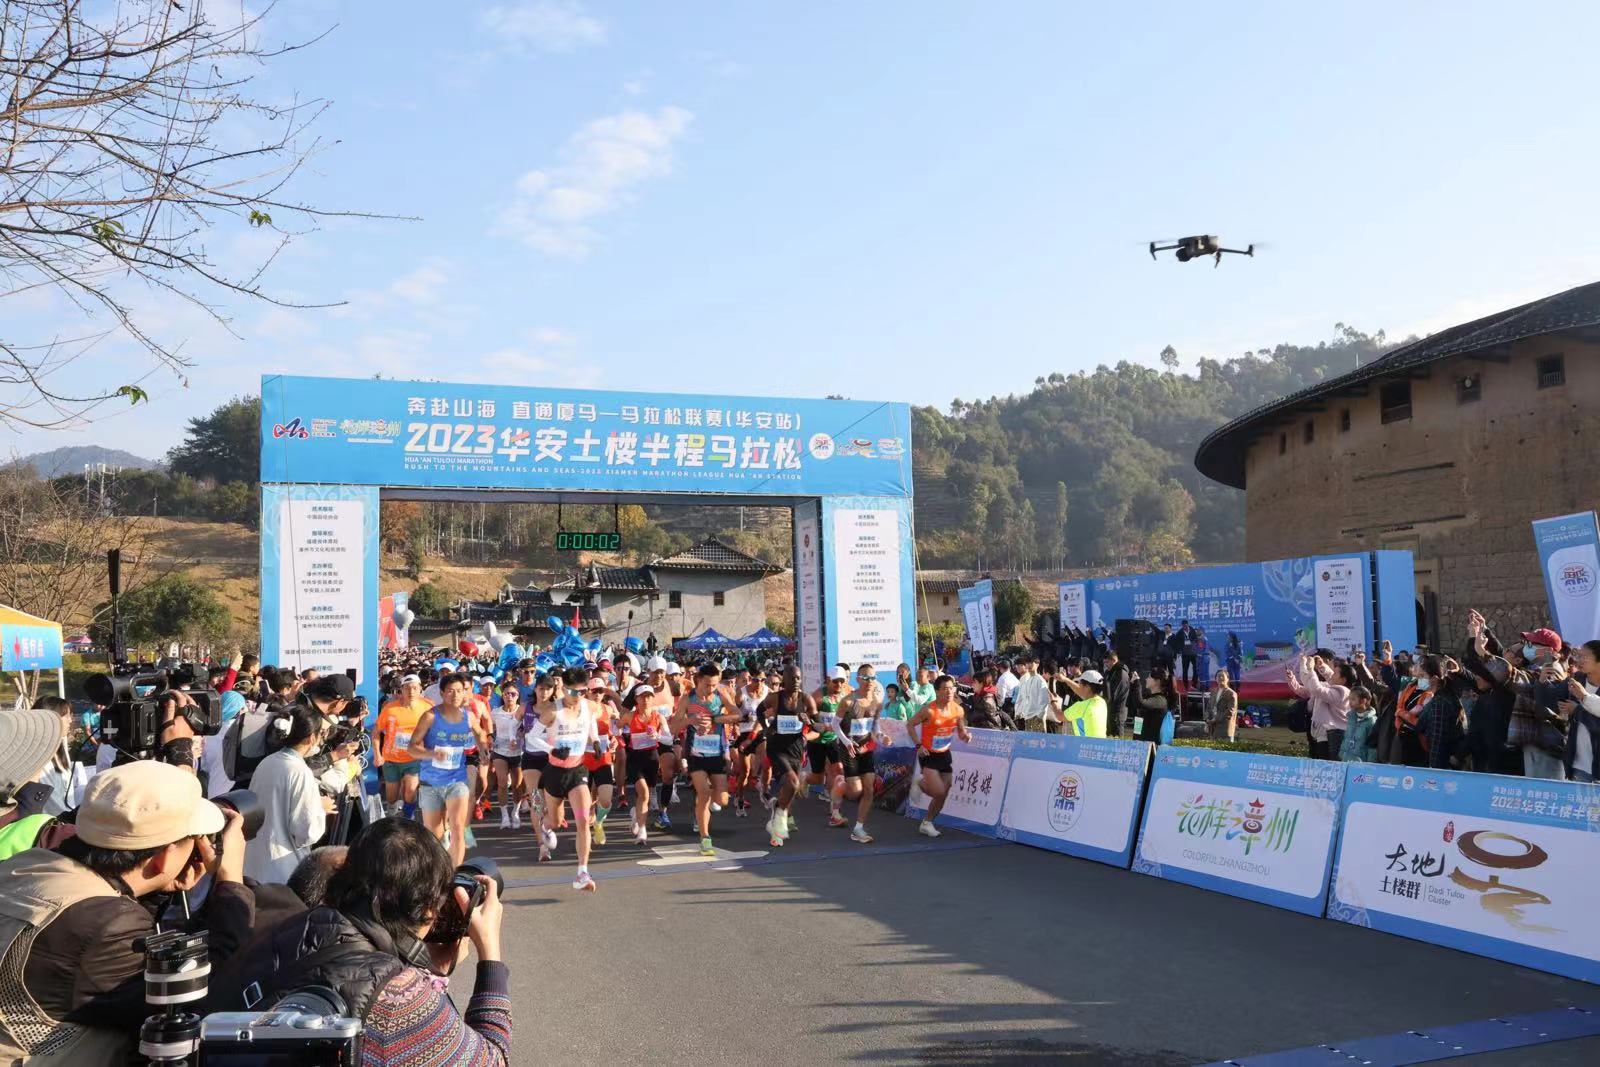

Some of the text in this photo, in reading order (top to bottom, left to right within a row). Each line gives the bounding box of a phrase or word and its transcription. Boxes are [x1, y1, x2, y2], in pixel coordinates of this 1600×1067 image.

[407, 397, 496, 418] 奔赴山海
[404, 422, 803, 471] 2023华安土楼半程马拉松
[473, 465, 528, 473] MOUNTAINS
[642, 469, 689, 477] MARATHON
[558, 534, 620, 548] 0:00:02
[1134, 598, 1256, 621] 2023华安土楼半程马拉松
[1182, 849, 1271, 876] COLORFUL ZHANGZHOU
[1385, 843, 1445, 877] 大地
[1378, 875, 1422, 900] 土楼群
[1428, 885, 1466, 899] Dadi Tulou
[1428, 894, 1452, 905] Cluster
